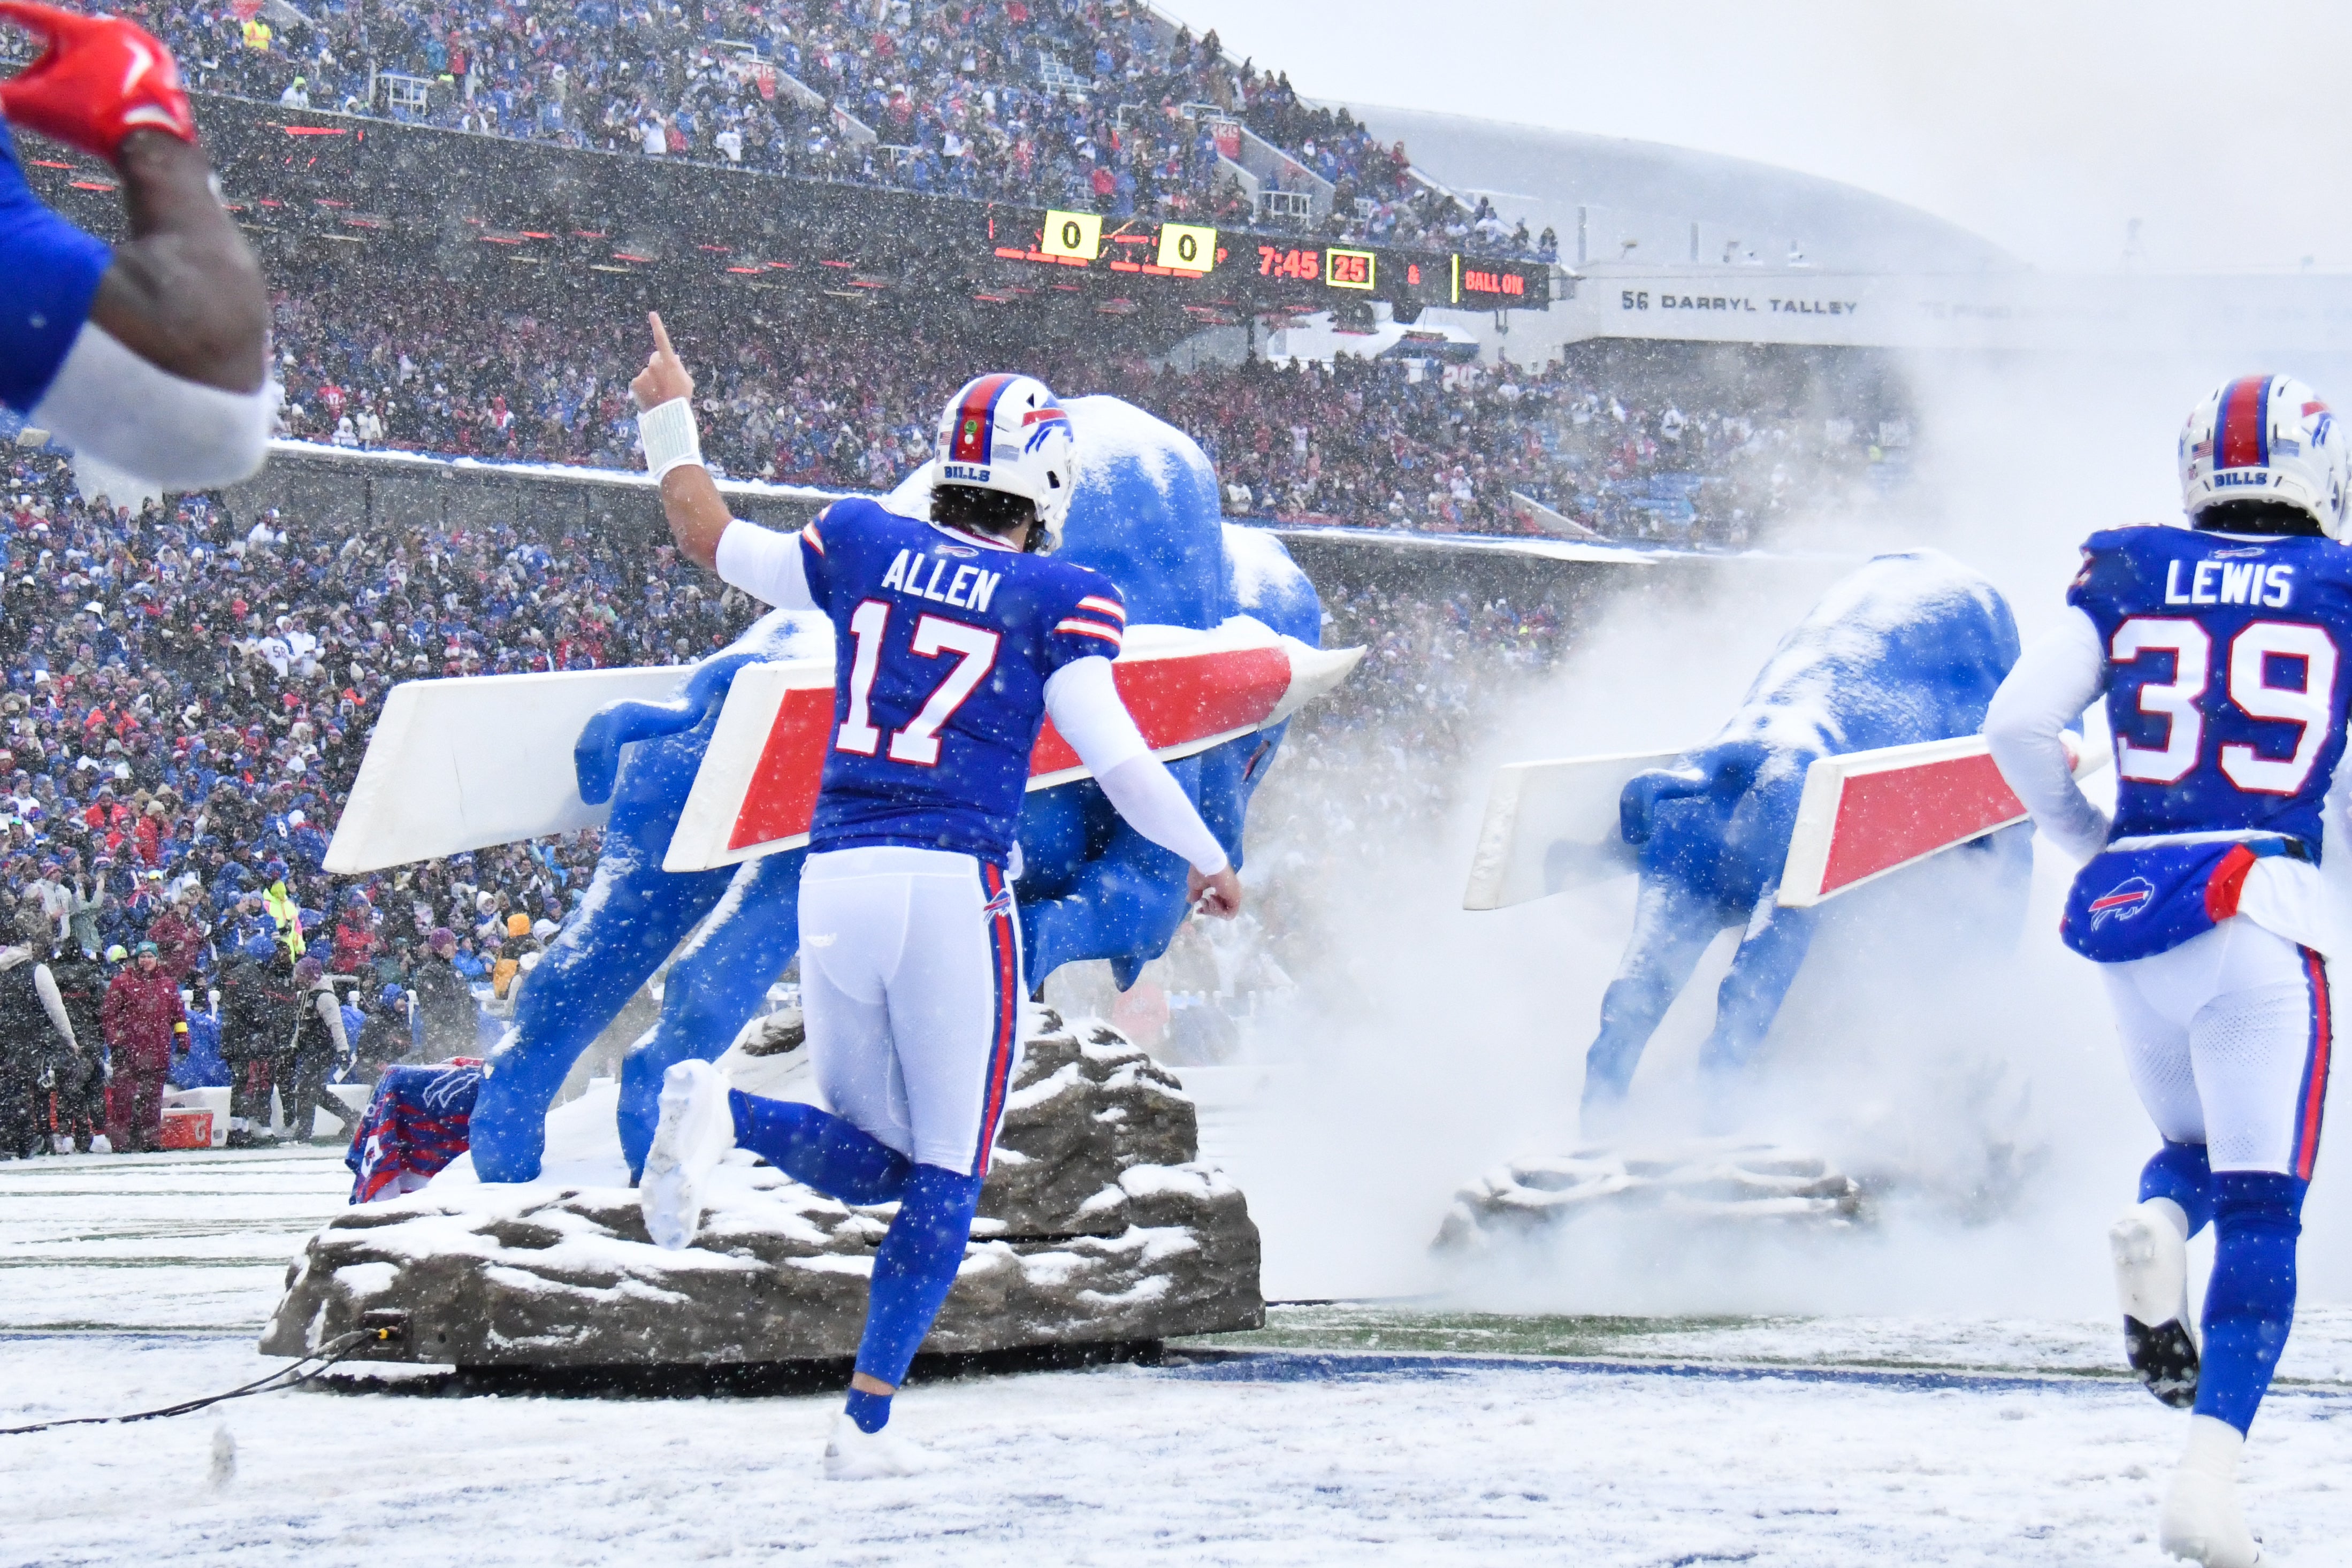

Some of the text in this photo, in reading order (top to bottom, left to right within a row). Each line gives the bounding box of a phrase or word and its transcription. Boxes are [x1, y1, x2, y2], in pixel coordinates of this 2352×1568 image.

[1063, 221, 1081, 249] 0
[1178, 234, 1197, 262] 0
[1258, 246, 1319, 280] 7:45
[1334, 255, 1366, 282] 25
[1408, 264, 1420, 285] &
[1465, 270, 1524, 295] BALL ON
[1622, 290, 1857, 315] 56 DARRYL TALLEY
[944, 466, 990, 483] BILLS
[2213, 472, 2268, 488] BILLS
[881, 549, 1000, 613] ALLEN
[2165, 559, 2294, 608] LEWIS
[836, 599, 1000, 767] 17
[2109, 615, 2338, 794] 39
[195, 1120, 207, 1142] G
